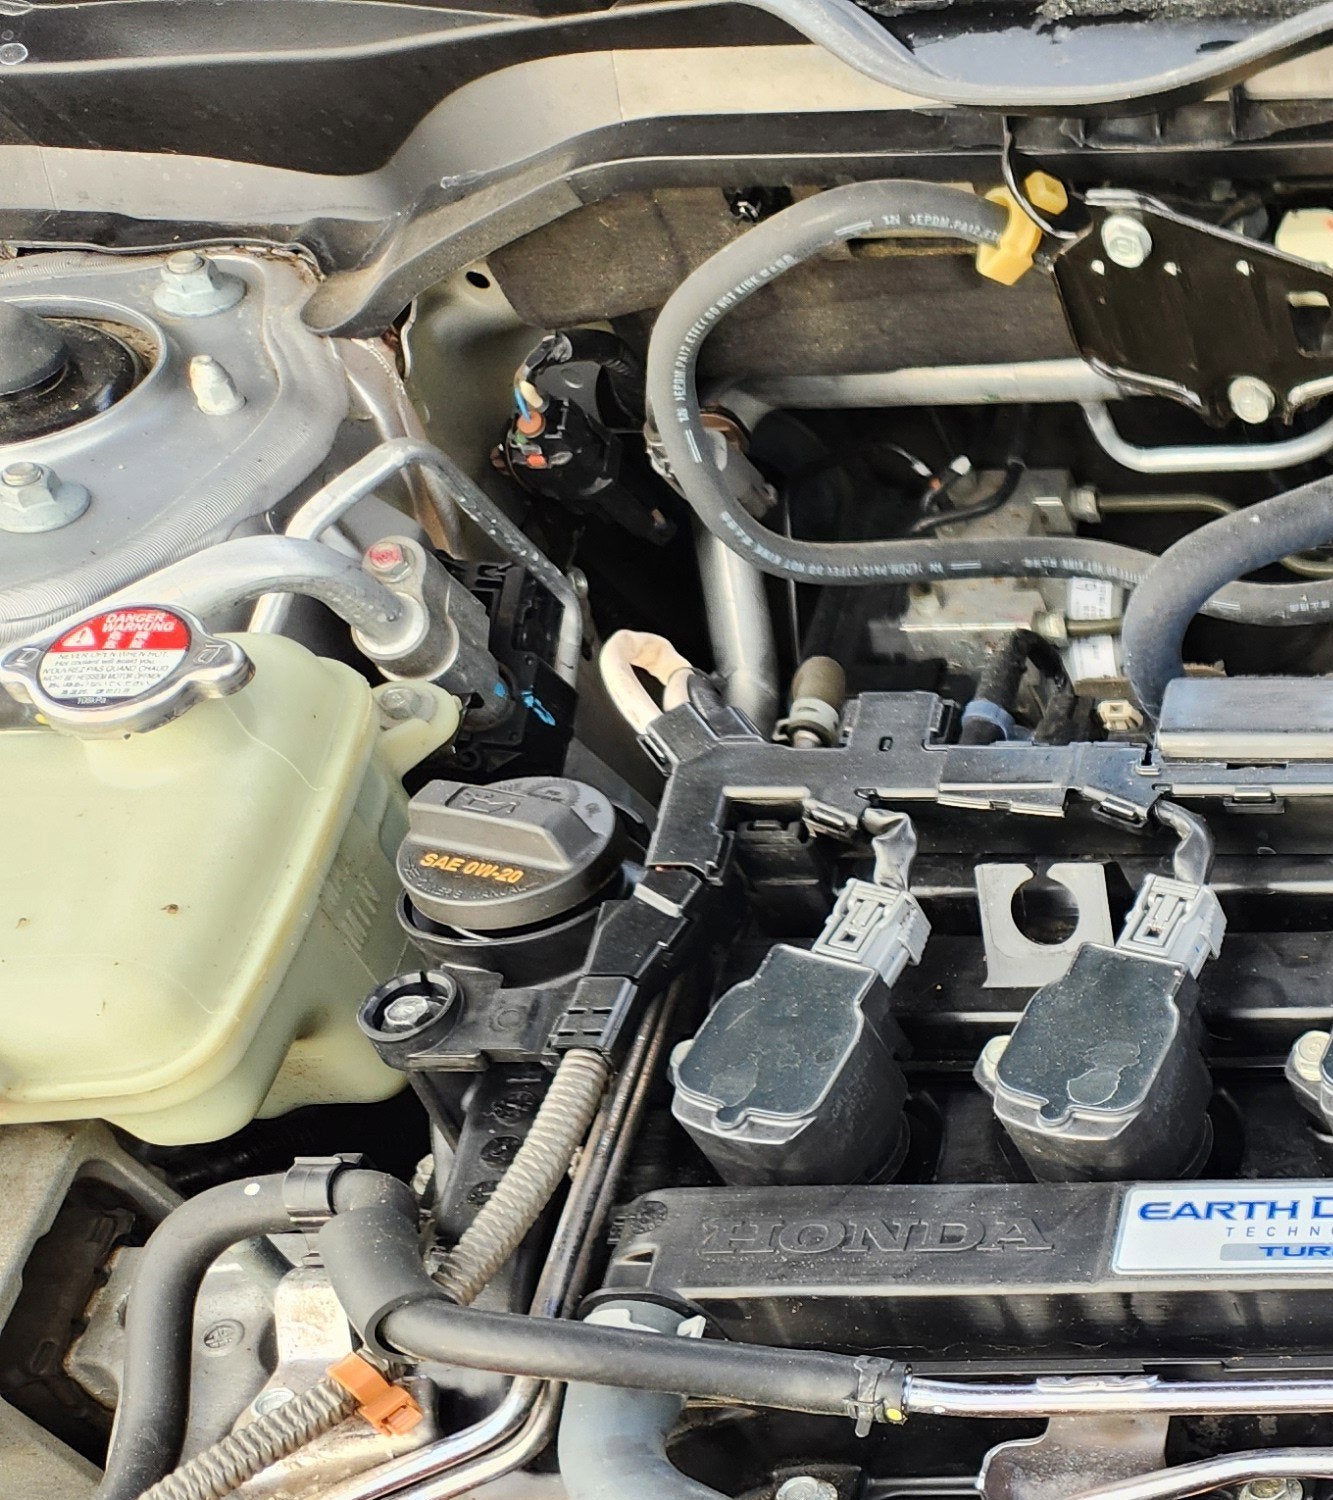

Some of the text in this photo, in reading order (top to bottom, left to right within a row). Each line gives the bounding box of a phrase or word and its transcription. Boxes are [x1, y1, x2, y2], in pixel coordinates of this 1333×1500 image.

[102, 621, 175, 633] WARNUNG
[106, 612, 166, 623] DANGER
[419, 853, 525, 884] SAE 0W-20
[1137, 1199, 1299, 1221] EARTH
[700, 1217, 1057, 1254] HONDA
